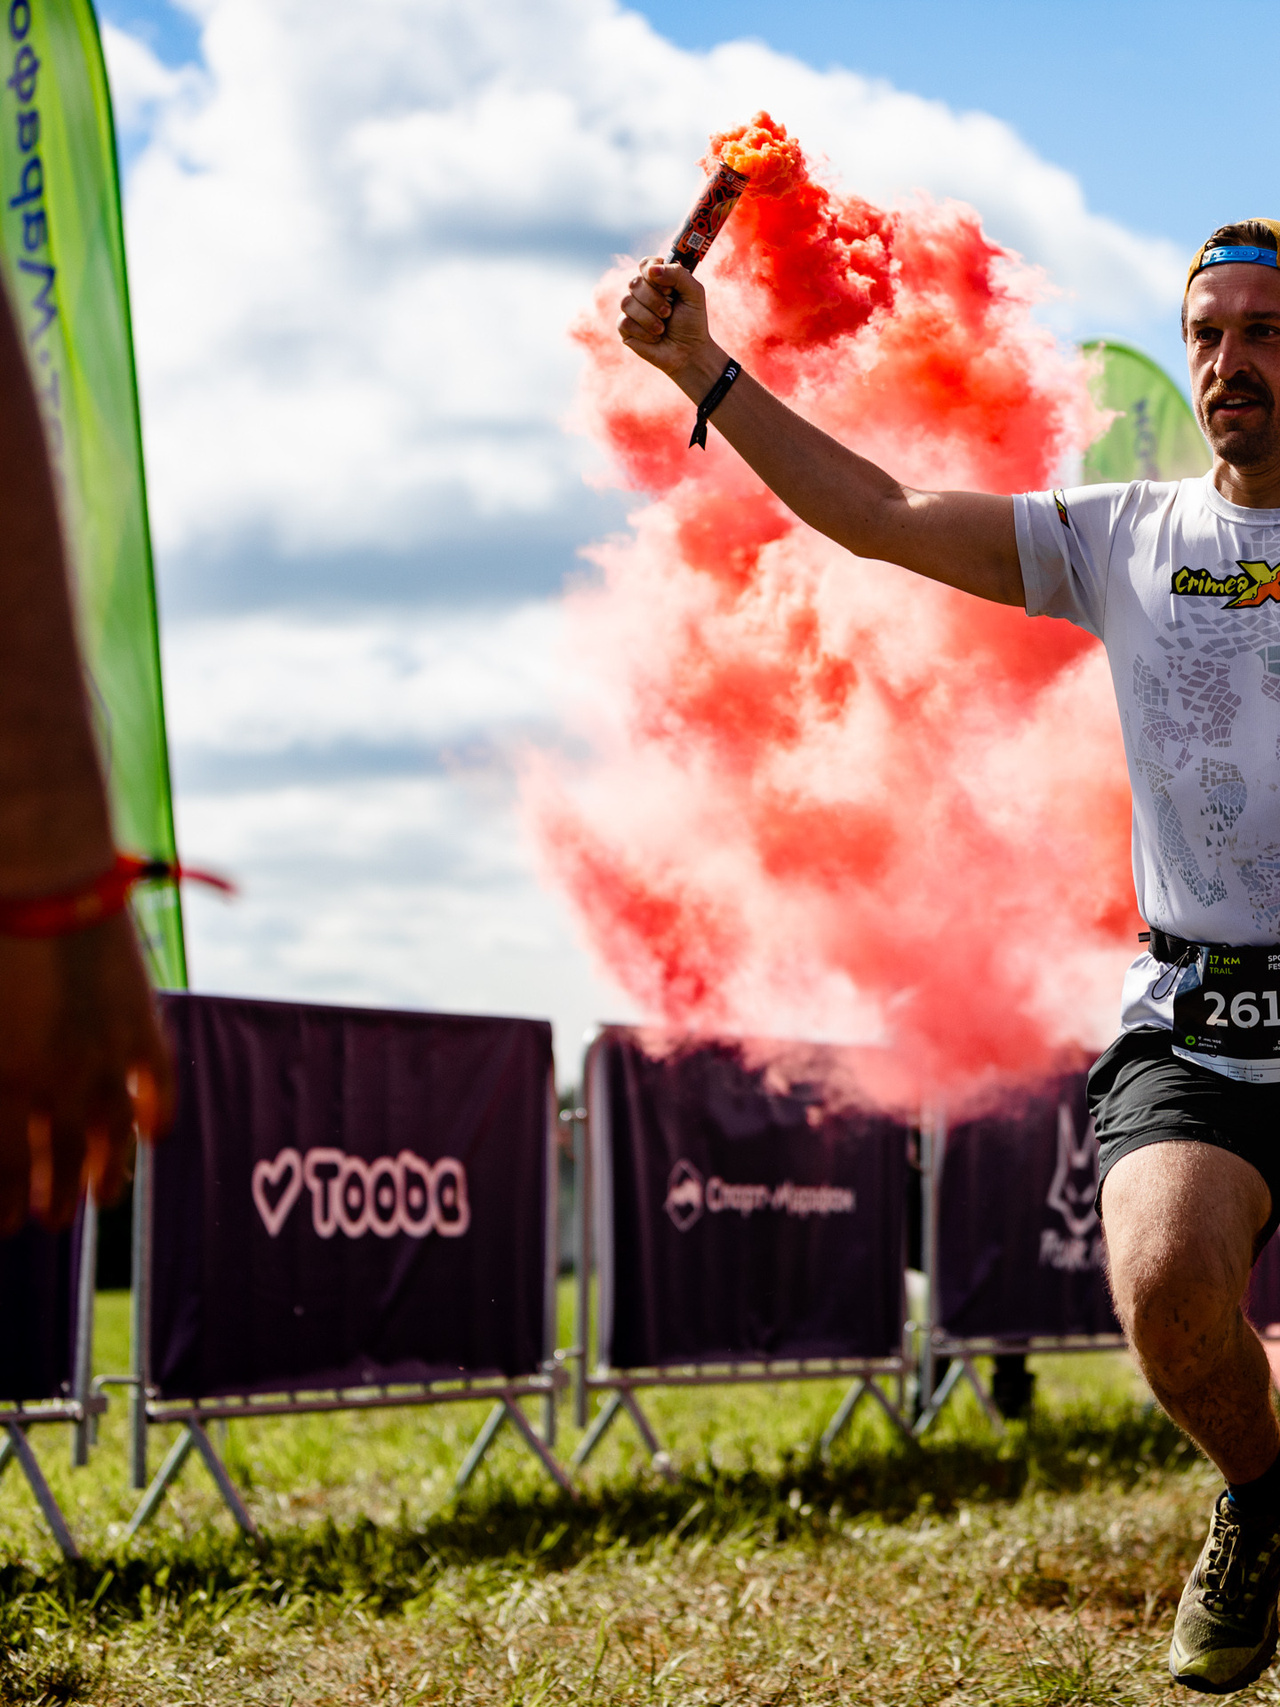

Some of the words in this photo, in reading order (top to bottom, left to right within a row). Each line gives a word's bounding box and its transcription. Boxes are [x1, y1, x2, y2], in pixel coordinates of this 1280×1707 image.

[1208, 954, 1220, 965] 17
[1222, 956, 1241, 965] KM
[1208, 966, 1233, 975] TRAIL
